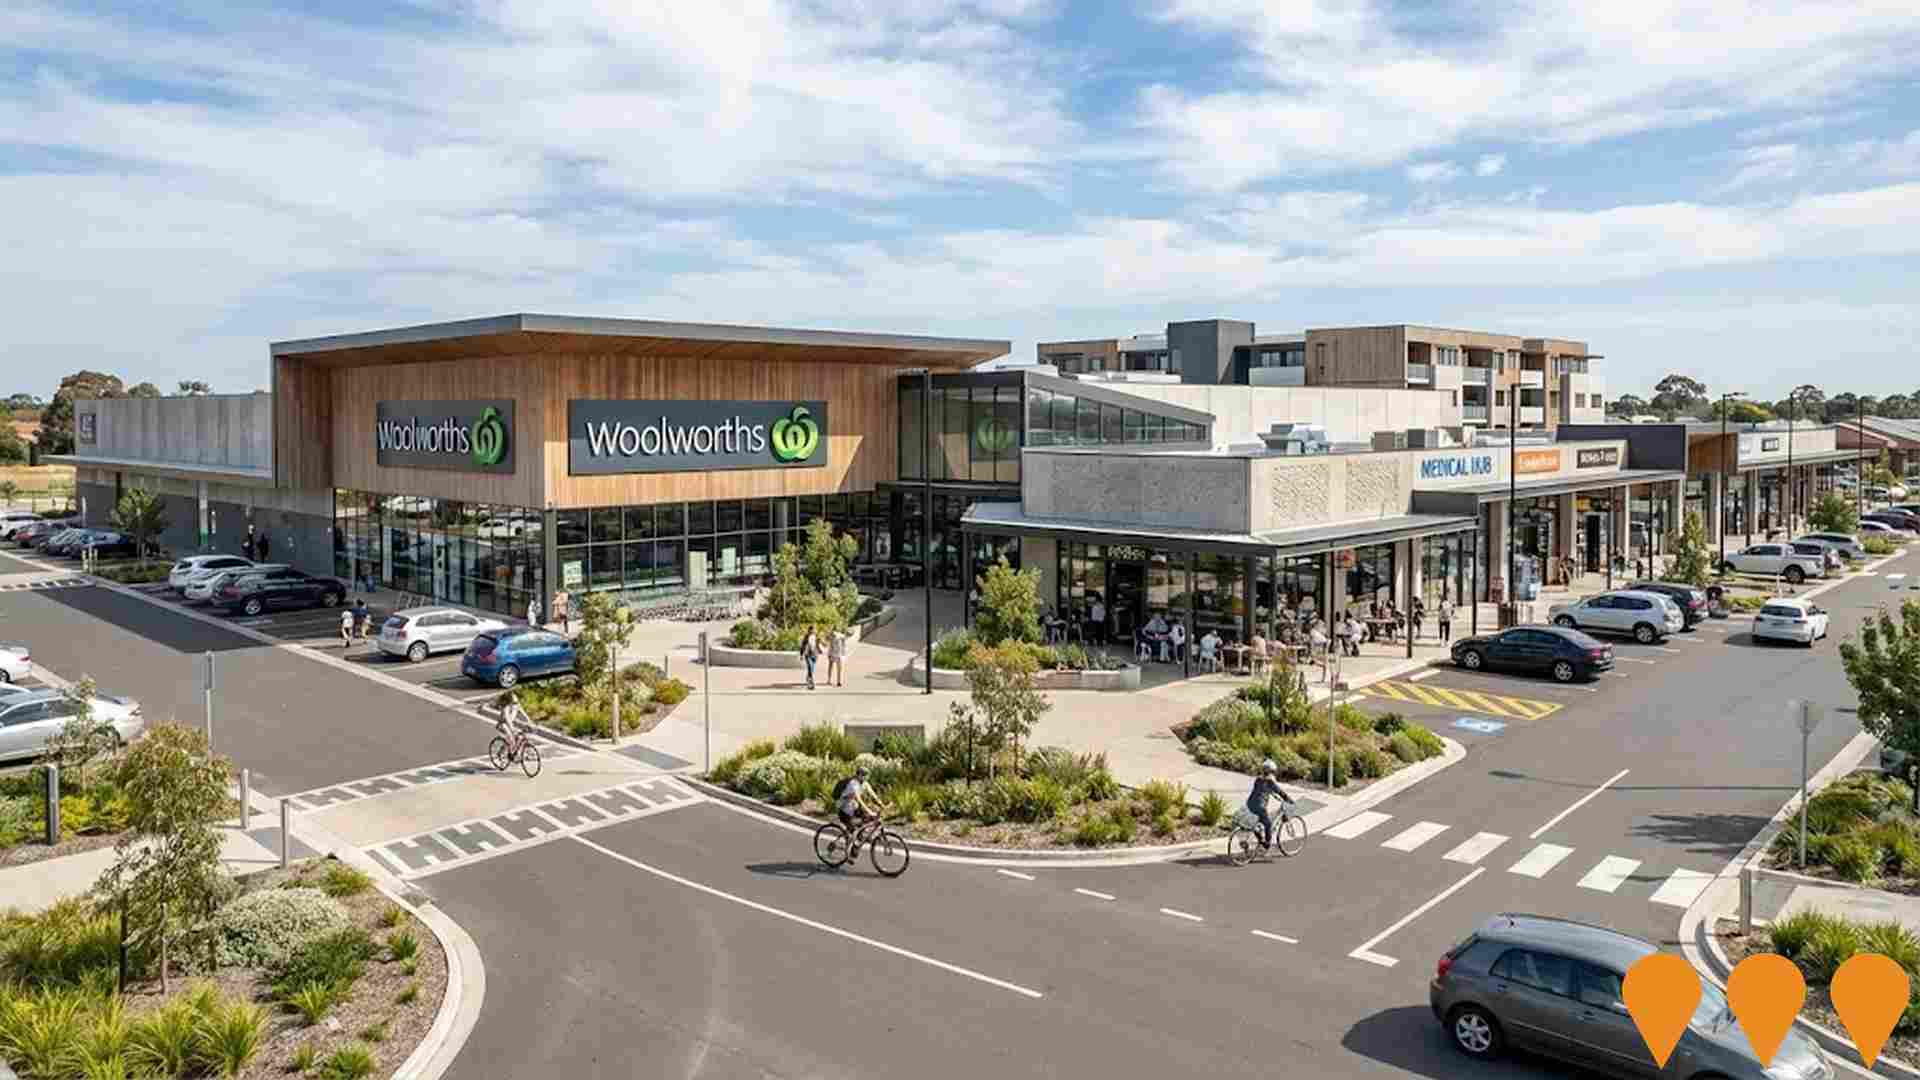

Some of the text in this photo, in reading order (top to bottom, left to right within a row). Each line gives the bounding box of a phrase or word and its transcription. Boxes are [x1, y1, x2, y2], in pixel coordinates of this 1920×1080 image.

[378, 417, 470, 454] Woolworths
[586, 416, 766, 456] Woolworths
[1421, 456, 1469, 478] MEDICAL
